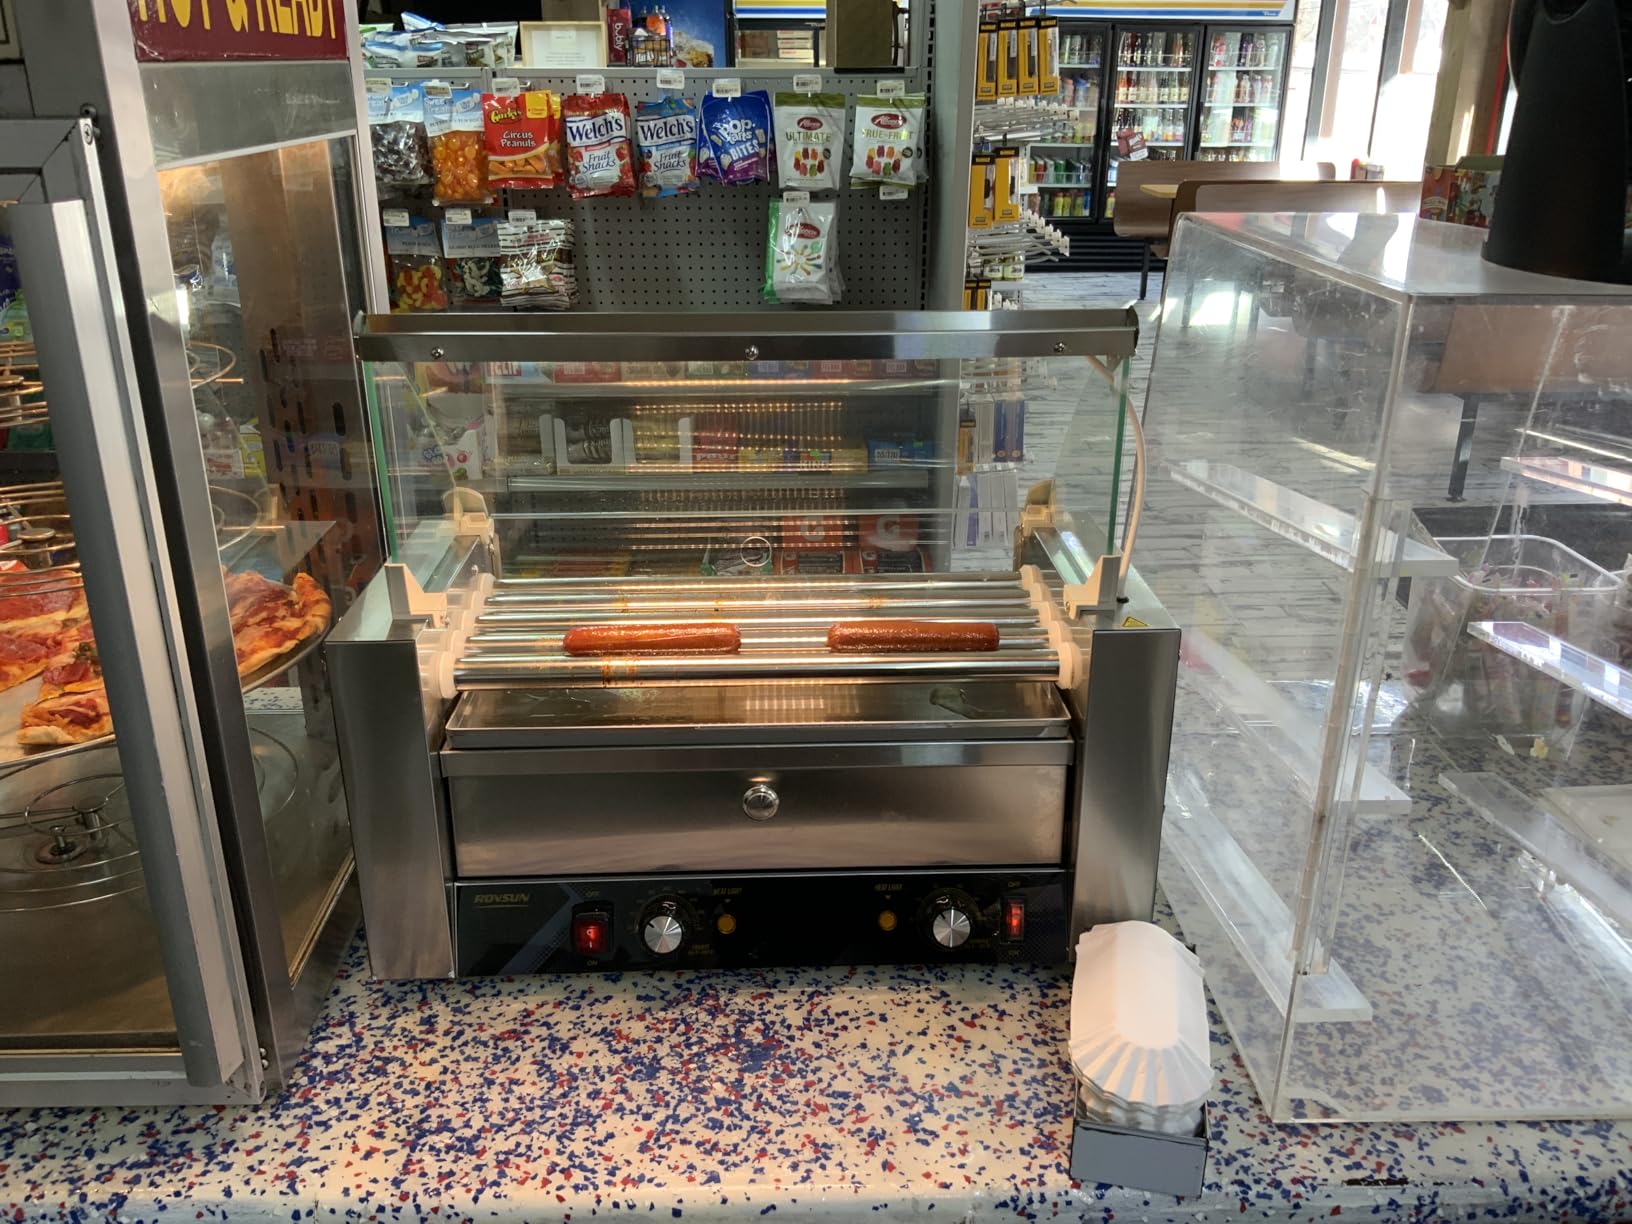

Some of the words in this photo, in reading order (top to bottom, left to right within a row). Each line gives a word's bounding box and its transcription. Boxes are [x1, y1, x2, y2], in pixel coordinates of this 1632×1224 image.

[614, 22, 624, 51] bubly
[503, 131, 533, 139] Circus
[567, 116, 623, 142] Welch's
[640, 119, 694, 142] Welch's
[500, 138, 536, 147] Peanuts
[785, 131, 832, 142] ULTIMATE
[729, 139, 760, 160] BITES
[588, 151, 610, 162] Fruit
[660, 151, 681, 161] Fruit
[582, 159, 616, 174] Snacks
[654, 159, 687, 172] Snacks
[474, 893, 530, 904] ROVSUN
